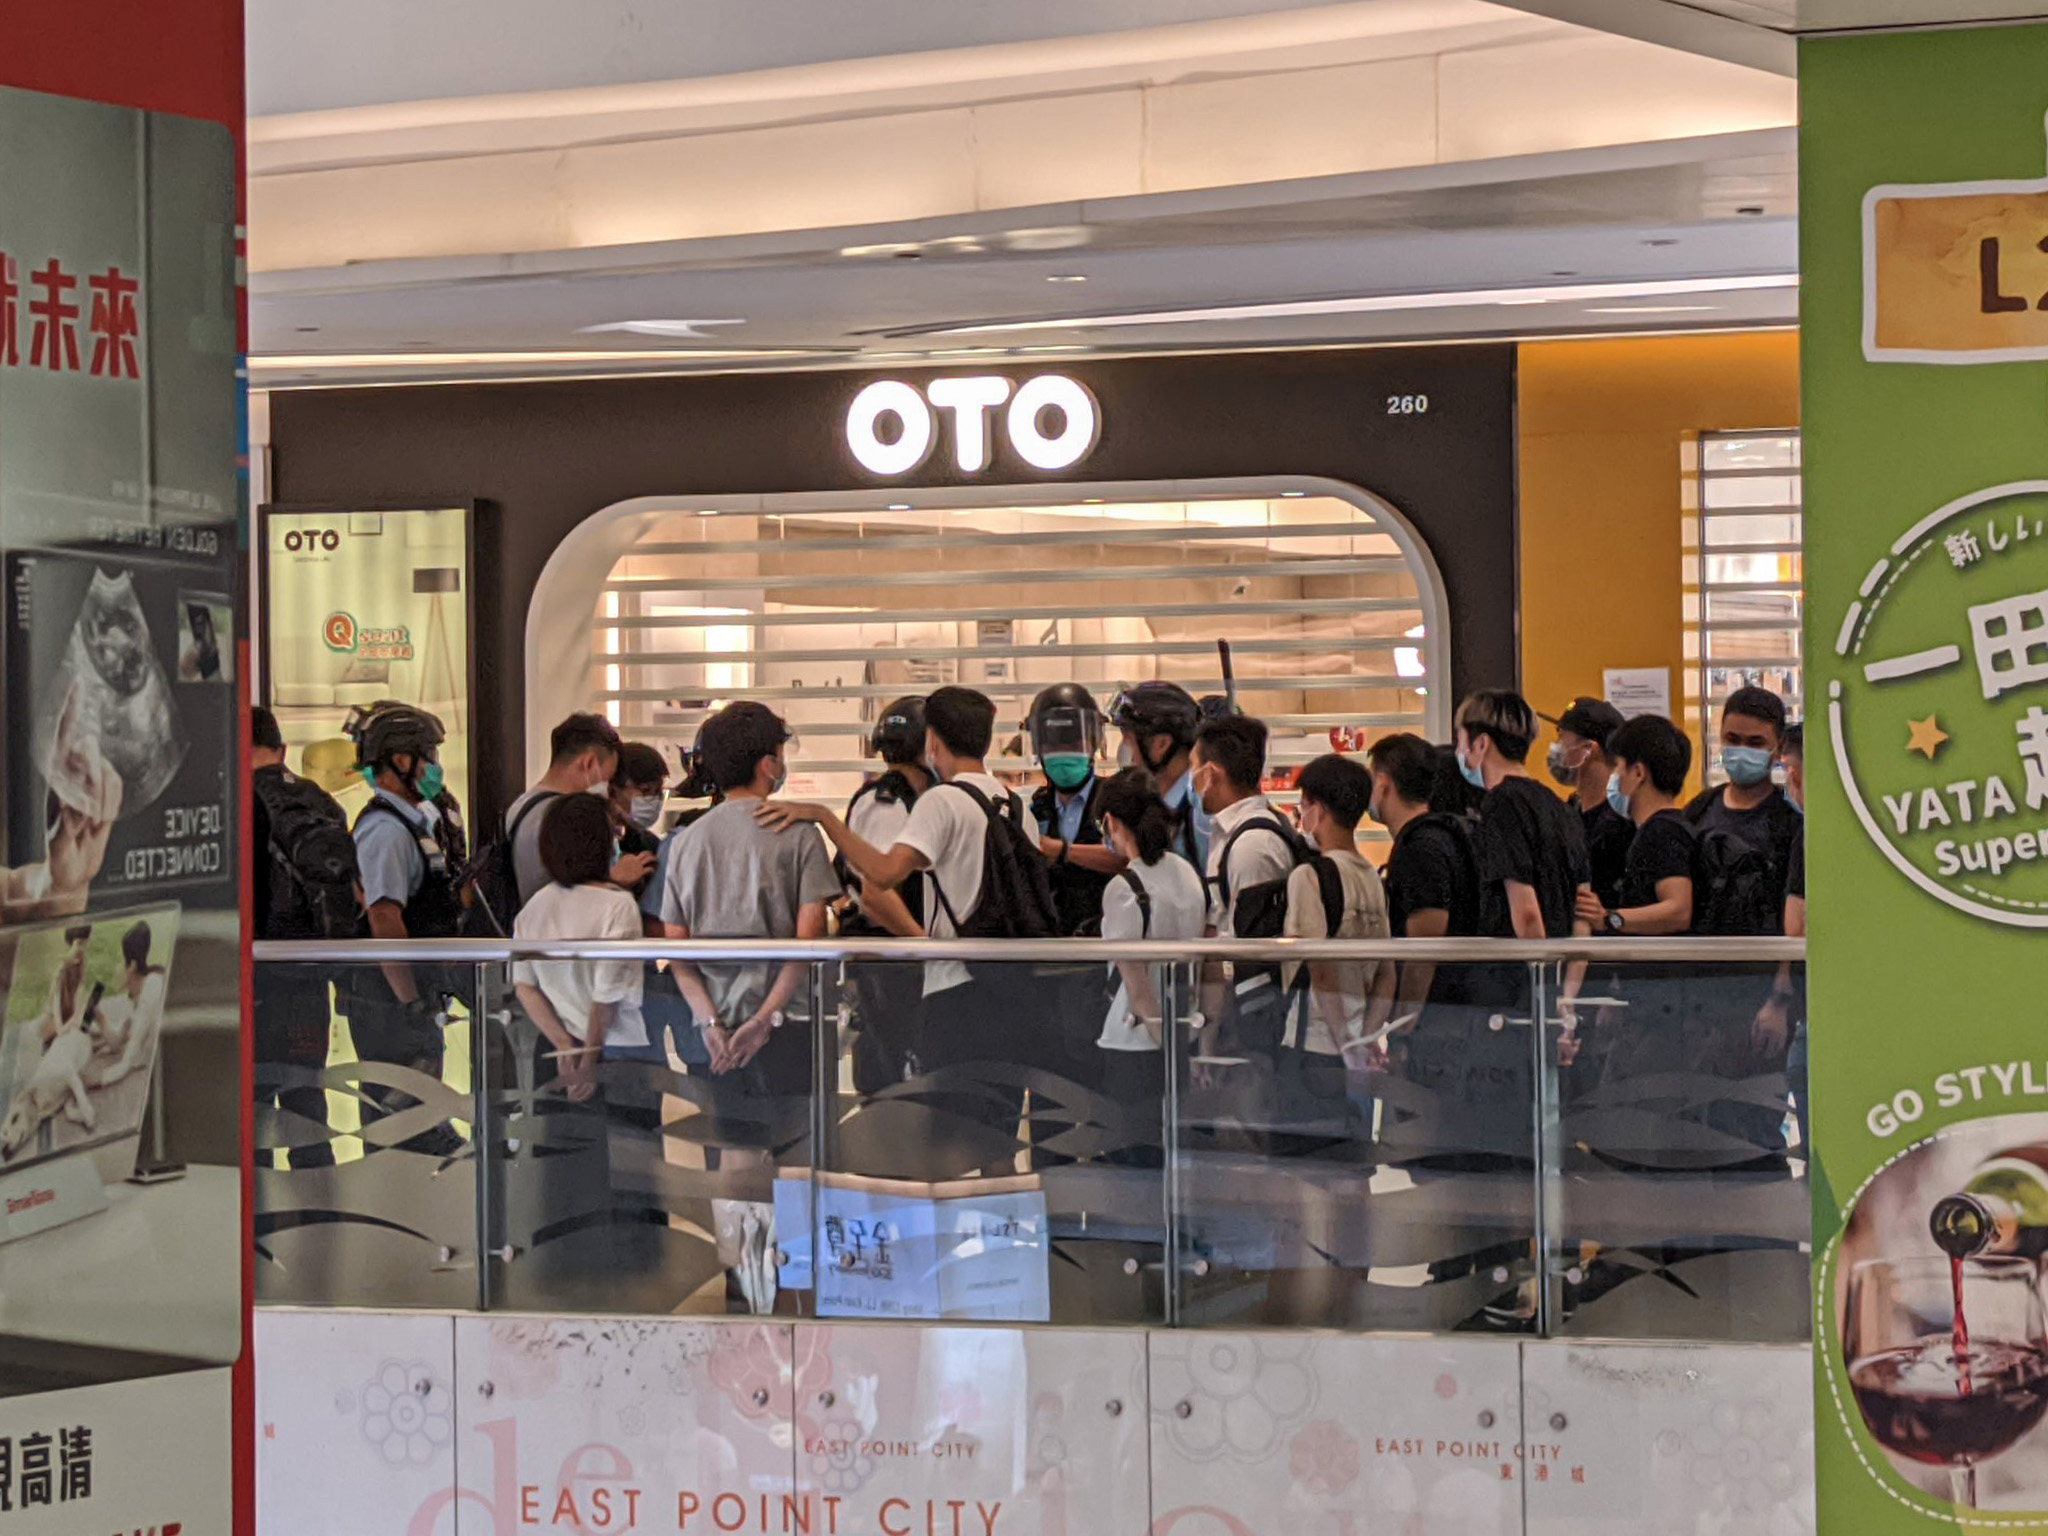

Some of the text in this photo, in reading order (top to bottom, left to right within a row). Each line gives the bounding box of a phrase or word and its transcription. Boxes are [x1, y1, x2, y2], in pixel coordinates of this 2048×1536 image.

[1980, 236, 2048, 313] L
[846, 375, 1099, 475] OTO
[1387, 395, 1428, 414] 260
[285, 529, 340, 551] OTO
[1882, 775, 2016, 834] YATA
[1866, 1059, 2048, 1138] GO STYL
[804, 1439, 977, 1459] EAST POINT CITY
[1375, 1438, 1563, 1460] EAST POINT CITY
[520, 1485, 642, 1527] EAST
[678, 1490, 841, 1535] POINT
[878, 1496, 1002, 1536] CITY
